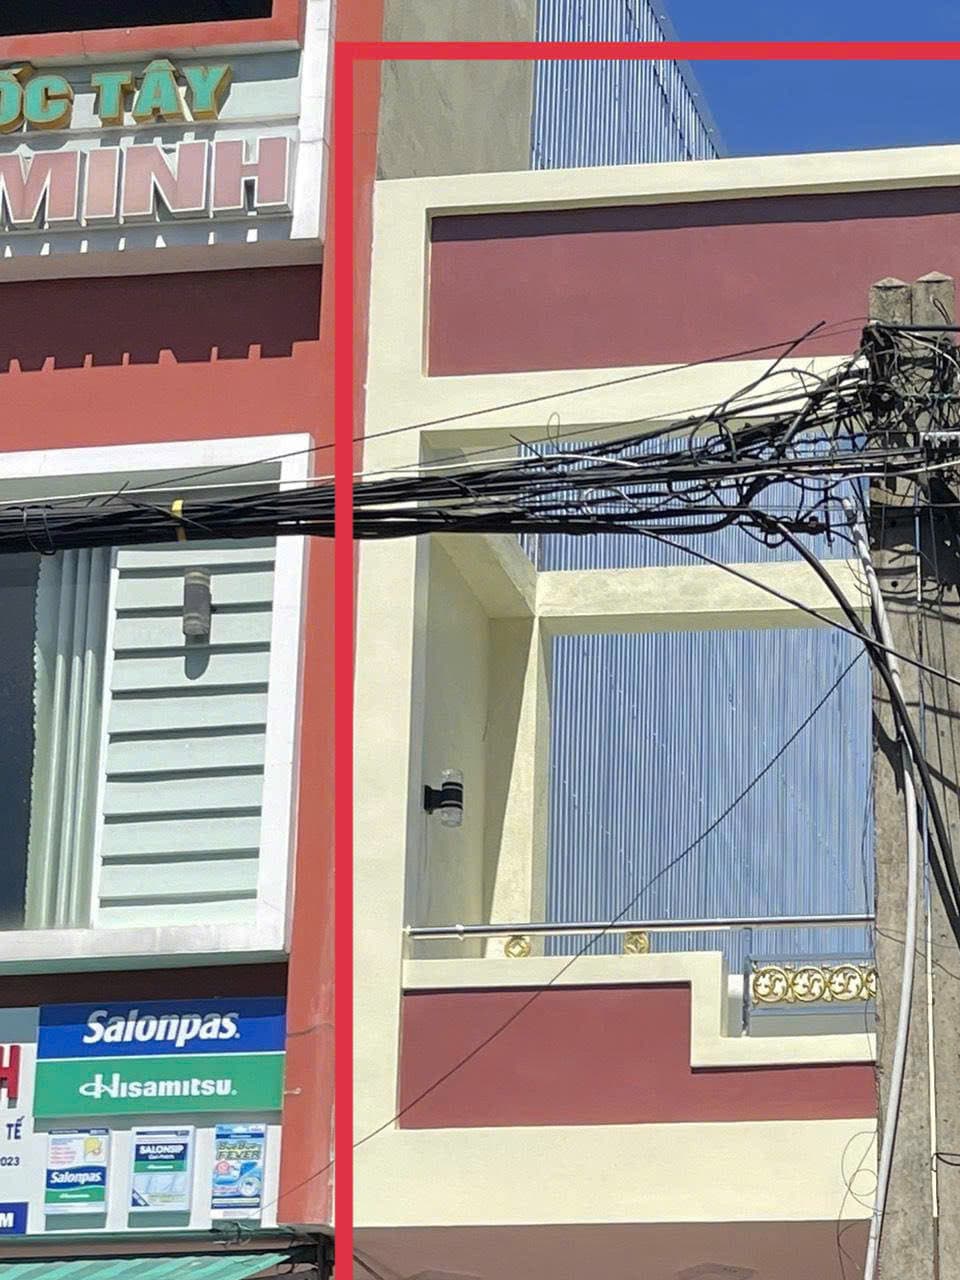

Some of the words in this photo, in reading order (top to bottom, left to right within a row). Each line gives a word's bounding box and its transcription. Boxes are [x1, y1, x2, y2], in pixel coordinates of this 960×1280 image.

[90, 59, 232, 126] TÂY
[0, 136, 290, 225] MINH
[6, 1115, 25, 1140] TẾ
[50, 1171, 102, 1184] Salonpas
